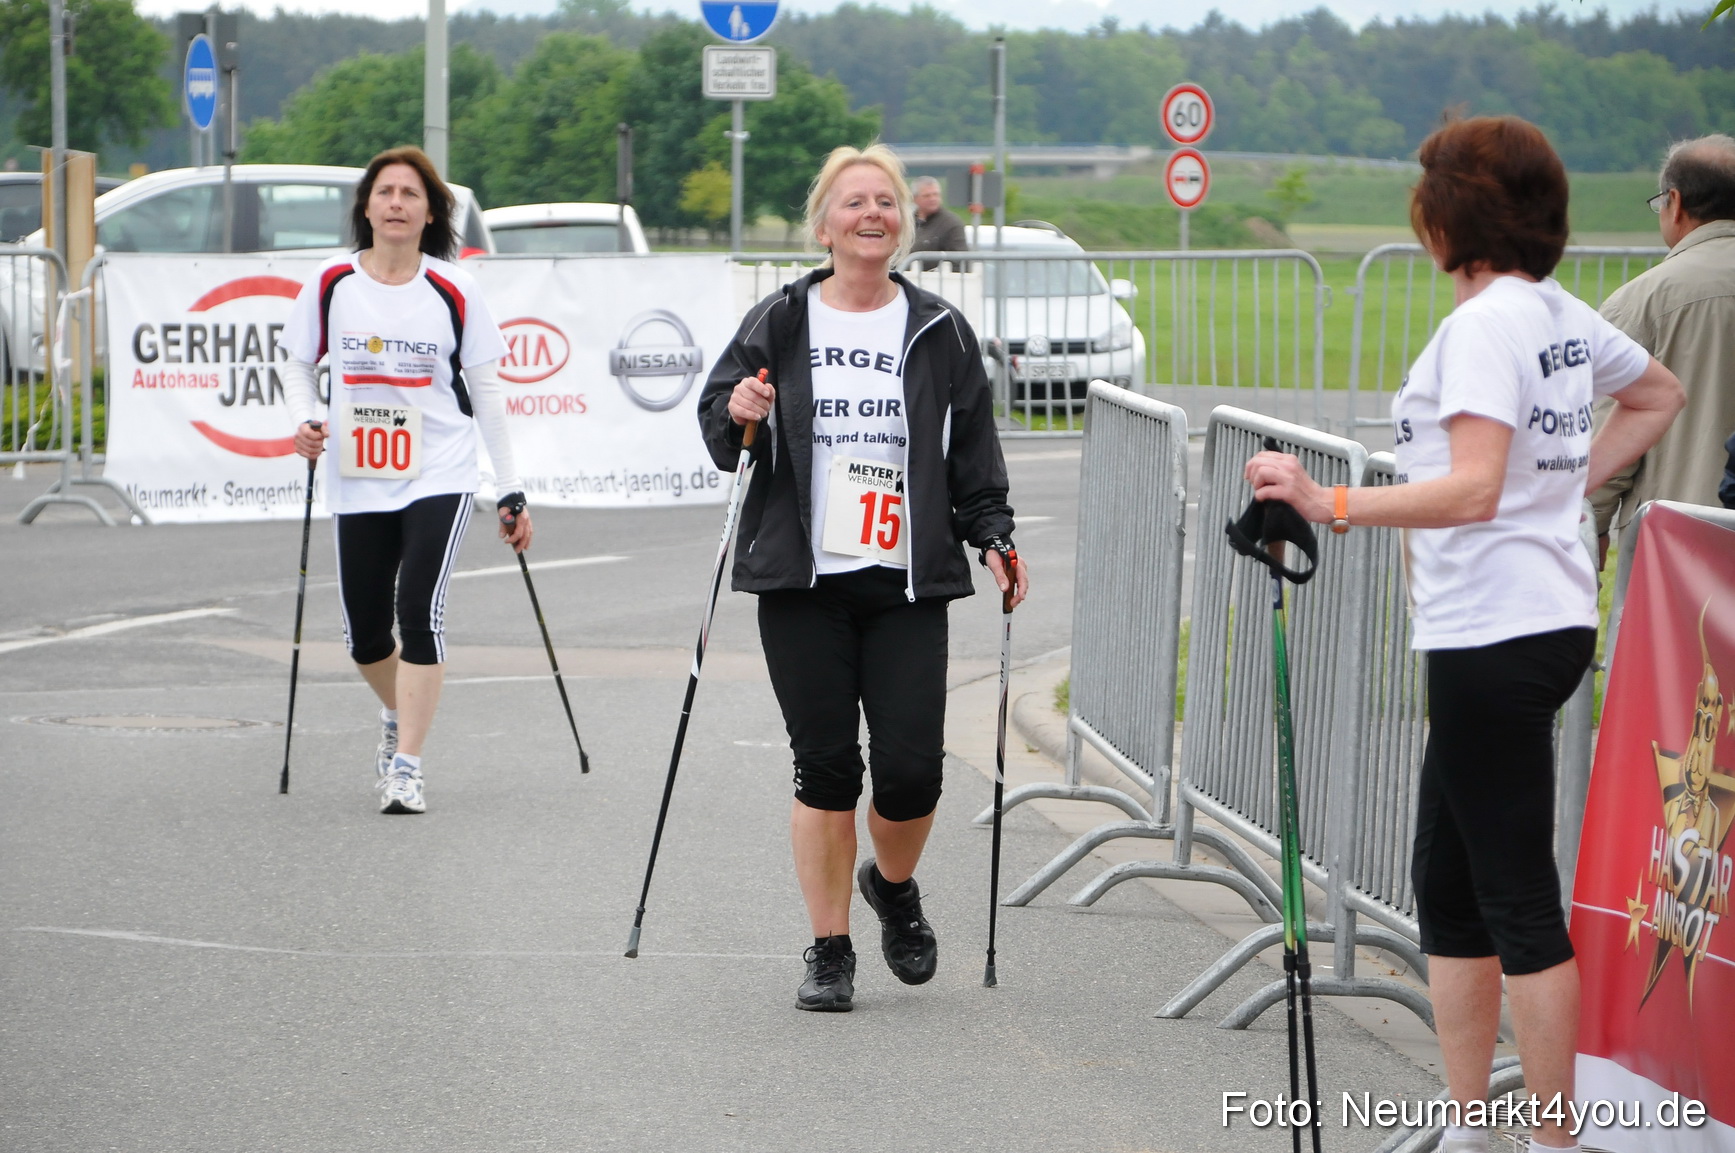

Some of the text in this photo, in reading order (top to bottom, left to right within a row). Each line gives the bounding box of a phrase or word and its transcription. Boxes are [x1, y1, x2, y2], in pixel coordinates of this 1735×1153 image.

[1173, 101, 1202, 127] 60
[132, 322, 289, 364] GERHAR
[500, 333, 554, 368] KIA
[619, 352, 694, 370] NISSAN
[132, 368, 220, 390] Autohaus
[353, 406, 391, 418] MEYER
[506, 393, 588, 416] MOTORS
[858, 397, 904, 418] GIR
[353, 415, 391, 425] WERBUNG
[351, 426, 412, 472] 100
[812, 431, 907, 448] ing and talking
[848, 462, 894, 481] MEYER
[1537, 454, 1577, 474] walking
[848, 473, 894, 490] WERBUNG
[126, 481, 207, 510] Neumarkt
[223, 480, 320, 512] Sengenthl
[859, 490, 902, 551] 15
